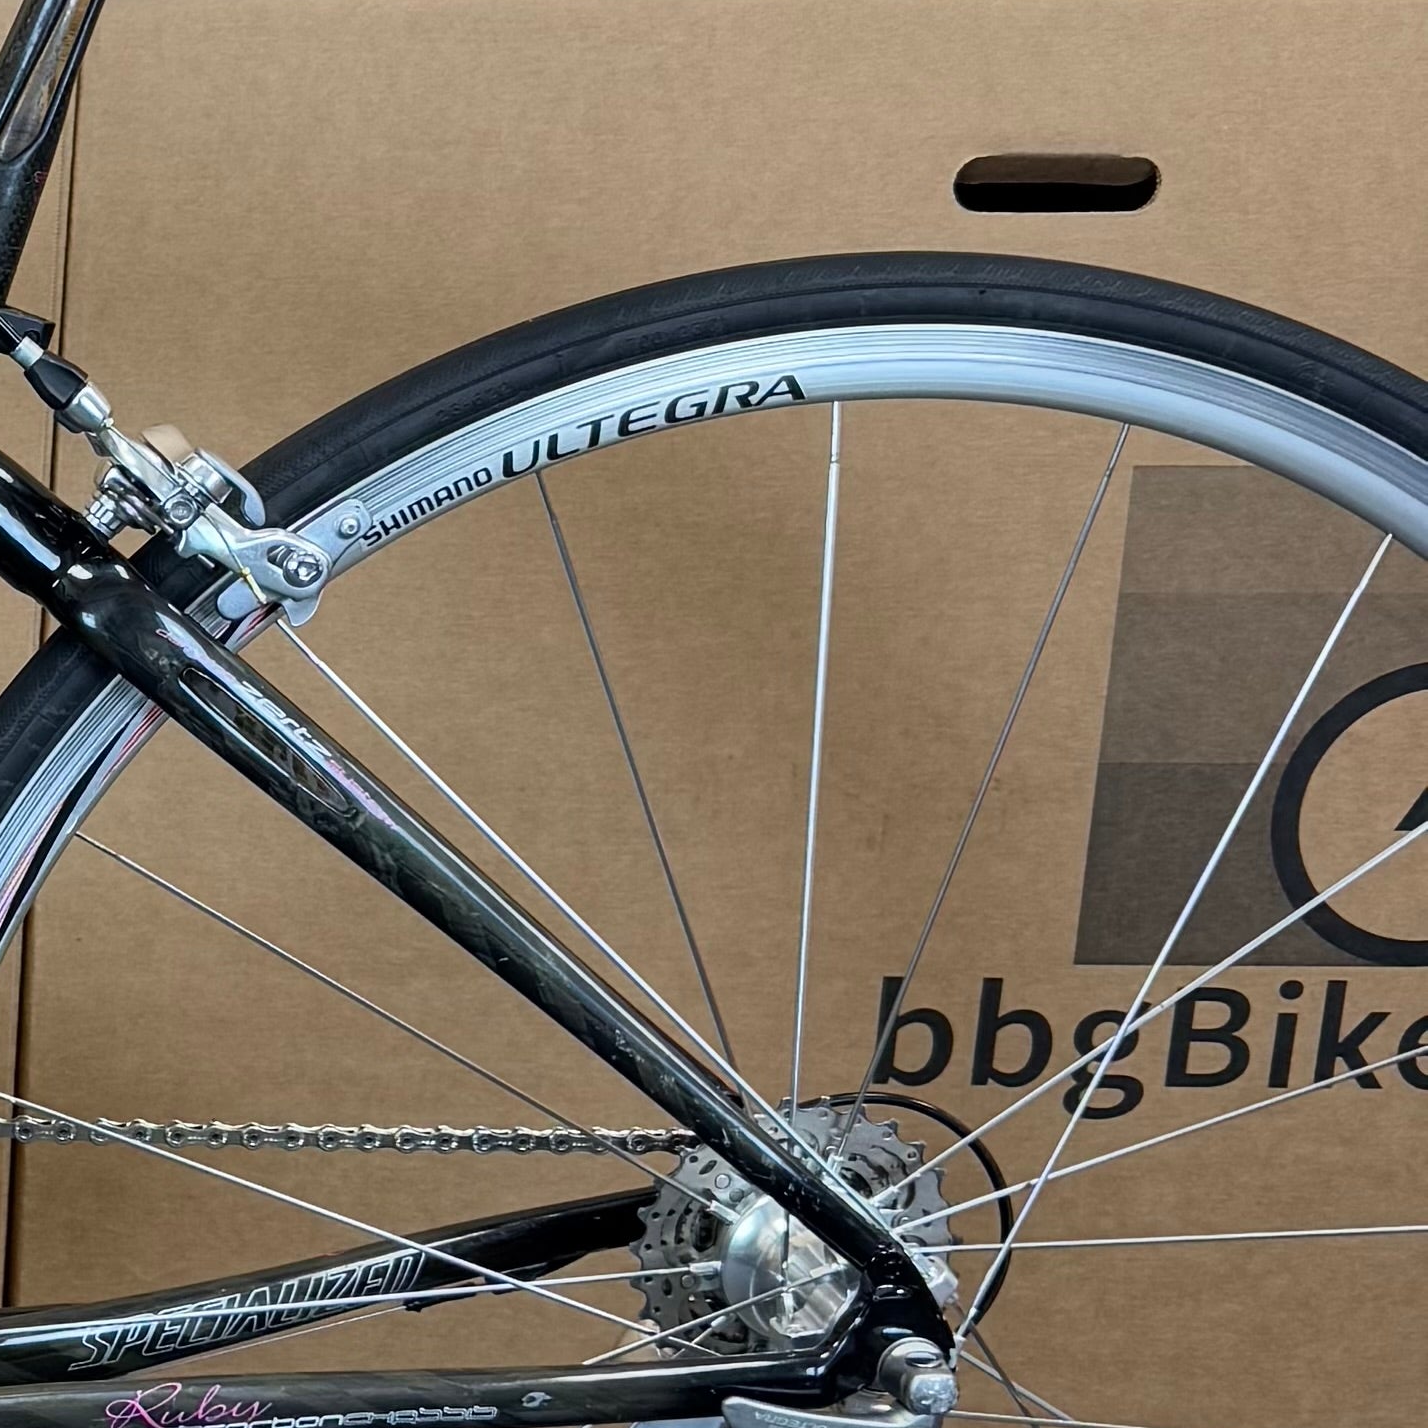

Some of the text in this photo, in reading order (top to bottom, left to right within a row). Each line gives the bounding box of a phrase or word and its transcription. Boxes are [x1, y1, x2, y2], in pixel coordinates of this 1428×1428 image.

[361, 467, 492, 547] SHIMANO
[502, 374, 806, 478] ULTEGRA
[68, 1252, 426, 1371] SPECIALIZED
